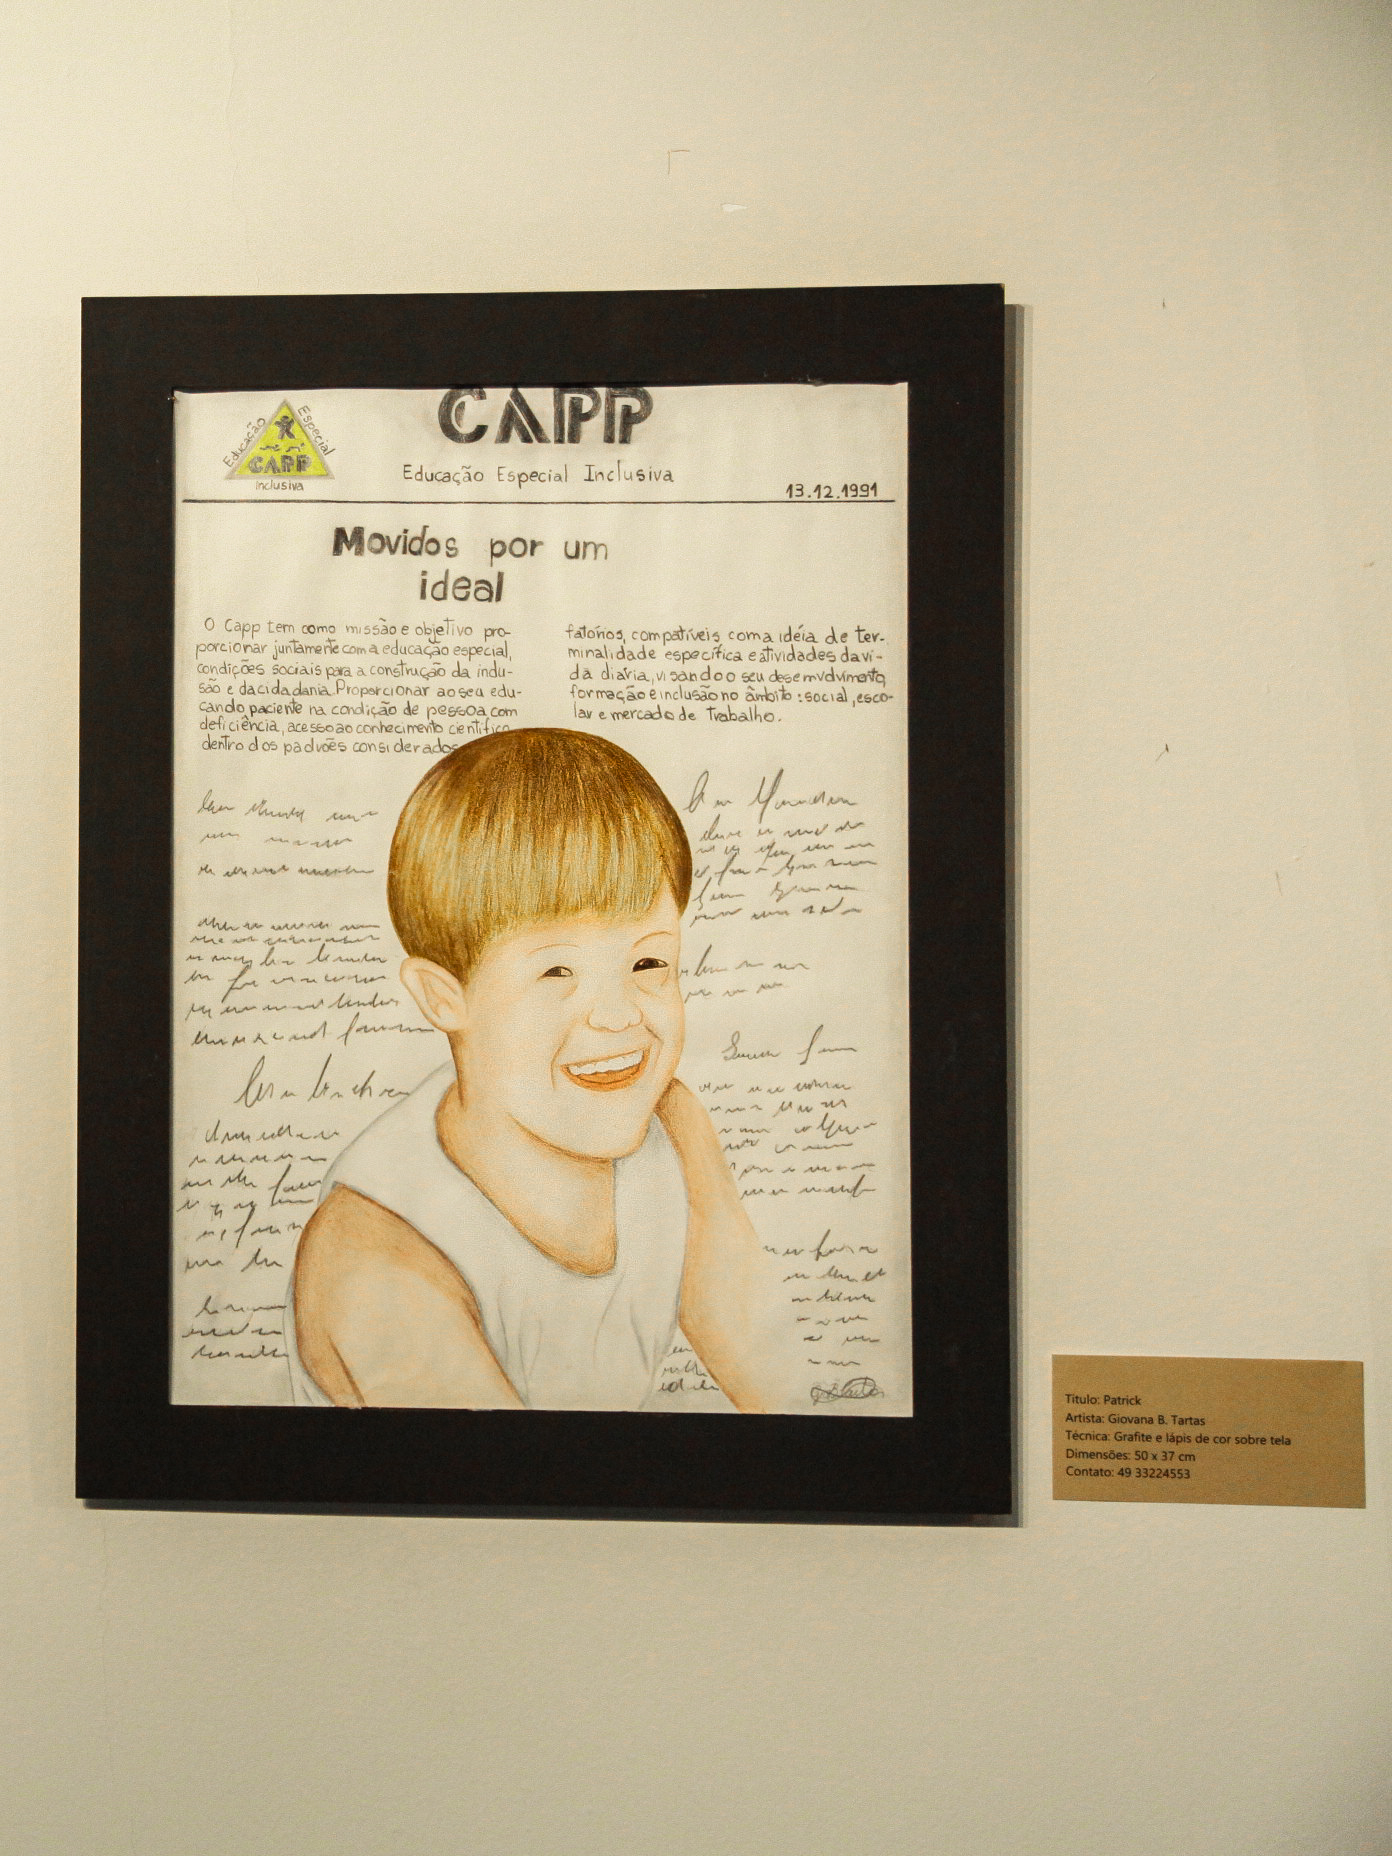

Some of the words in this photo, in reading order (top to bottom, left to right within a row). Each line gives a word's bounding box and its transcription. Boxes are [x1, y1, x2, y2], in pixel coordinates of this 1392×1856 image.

[438, 386, 654, 444] CAPP
[297, 405, 336, 456] Especial
[248, 454, 312, 474] CAPP
[402, 463, 484, 486] Educação
[497, 464, 568, 489] Especial
[583, 460, 675, 483] Inclusiva
[786, 482, 878, 499] 13.12.1991
[332, 525, 459, 558] Movidos
[490, 537, 544, 567] por
[563, 540, 609, 561] um
[419, 568, 505, 603] ideal
[204, 617, 215, 631] O
[224, 618, 261, 639] Capp
[267, 619, 295, 634] tem
[301, 624, 336, 635] como
[345, 617, 397, 636] missão
[401, 625, 409, 635] e
[415, 617, 473, 644] objetivo
[484, 627, 511, 642] pro-
[631, 625, 720, 646] compatíveis
[779, 624, 819, 643] idéia
[825, 626, 848, 645] de
[195, 641, 268, 660] porcionar
[453, 640, 512, 662] especial,
[568, 644, 656, 661] minalidade
[197, 658, 265, 679] condições
[272, 662, 322, 676] sociais
[325, 665, 353, 679] para
[356, 666, 367, 677] a
[370, 659, 446, 680] construção
[451, 660, 471, 678] da
[741, 671, 765, 682] seu
[198, 678, 221, 694] são
[227, 685, 234, 695] e
[490, 684, 522, 698] edu-
[570, 684, 646, 704] formação
[199, 698, 245, 713] cando
[249, 698, 303, 717] paciente
[309, 704, 327, 716] na
[331, 700, 397, 718] condição
[403, 701, 419, 716] de
[426, 705, 487, 720] pessoa
[490, 706, 518, 717] com
[598, 710, 607, 720] e
[610, 704, 675, 721] mercado
[679, 706, 697, 721] de
[199, 715, 285, 737] deficiência,
[355, 720, 444, 735] conhecimento
[202, 734, 244, 751] dentro
[248, 736, 278, 752] dos
[1103, 1394, 1142, 1407] Patrick
[1065, 1412, 1104, 1424] Artista:
[1108, 1413, 1154, 1425] Giovana
[1157, 1414, 1168, 1425] B.
[1171, 1414, 1206, 1426] Tartas
[1065, 1430, 1110, 1442] Técnica:
[1113, 1431, 1153, 1443] Grafite
[1155, 1434, 1163, 1443] e
[1166, 1432, 1192, 1446] lápis
[1195, 1432, 1210, 1444] de
[1212, 1435, 1231, 1445] cor
[1234, 1433, 1267, 1446] sobre
[1270, 1435, 1292, 1447] tela
[1066, 1448, 1131, 1461] Dimensões:
[1134, 1450, 1149, 1461] 50
[1151, 1452, 1158, 1461] x
[1161, 1450, 1175, 1461] 37
[1178, 1452, 1196, 1462] cm
[1065, 1465, 1114, 1478] Contato:
[1117, 1466, 1132, 1478] 49
[1135, 1467, 1191, 1479] 33224553
